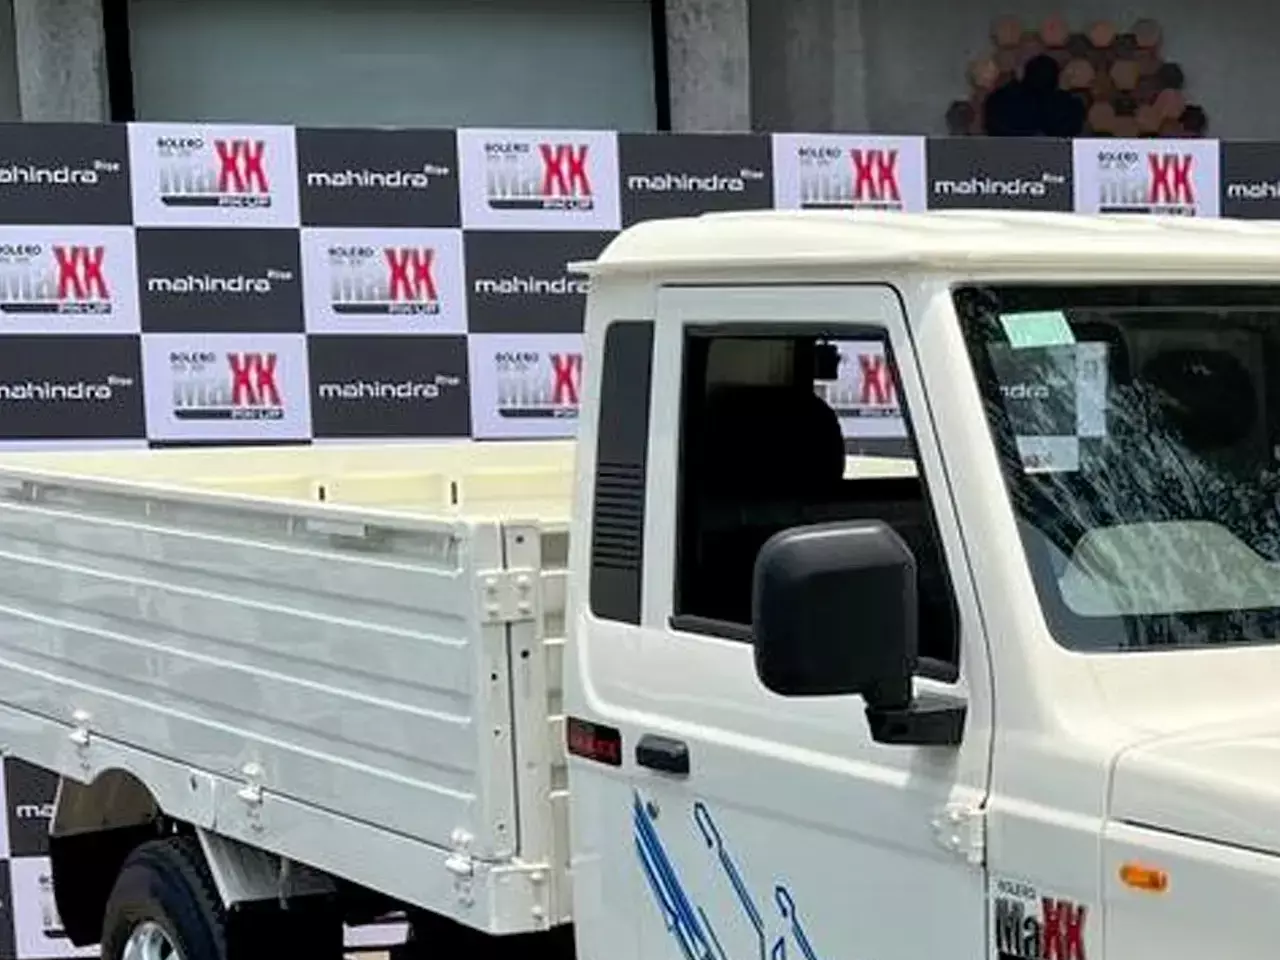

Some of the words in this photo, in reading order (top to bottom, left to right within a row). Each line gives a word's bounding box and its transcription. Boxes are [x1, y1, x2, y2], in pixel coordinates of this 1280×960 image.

[0, 166, 98, 184] ahindra
[307, 169, 428, 187] mahindra
[628, 173, 745, 191] mahindra
[934, 177, 1046, 195] mahindra
[148, 274, 271, 292] mahindra
[318, 380, 440, 398] mahindra
